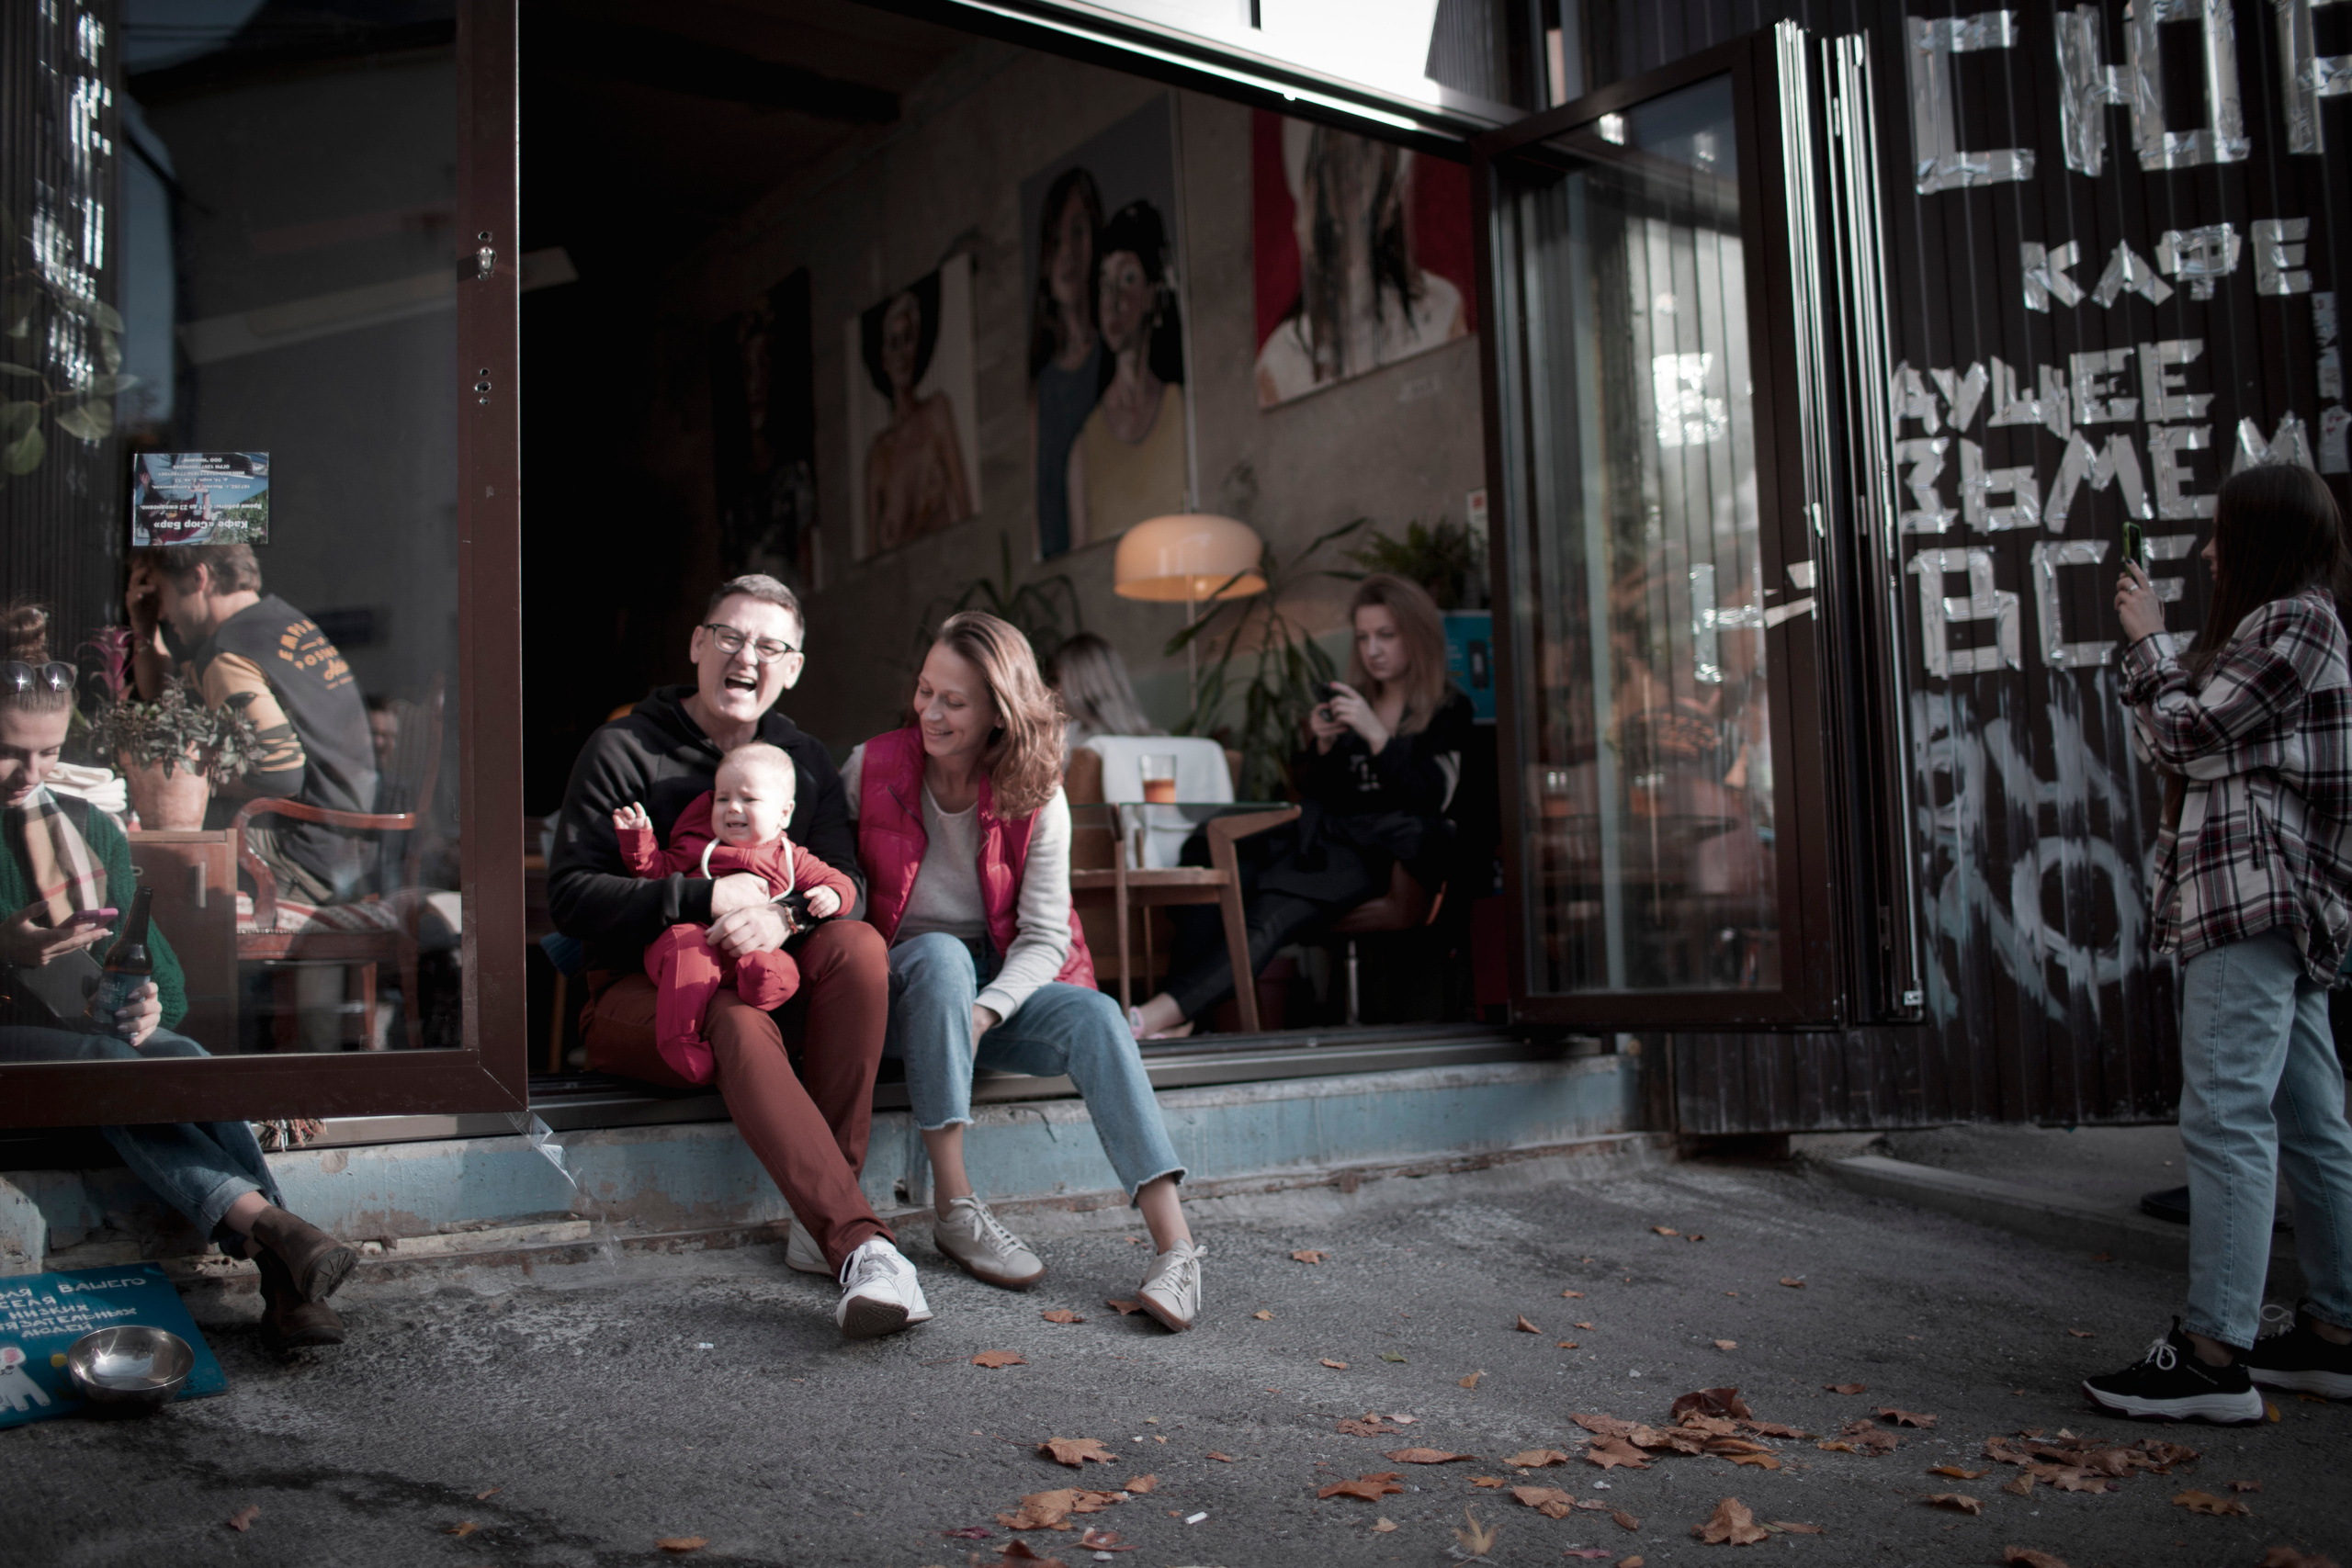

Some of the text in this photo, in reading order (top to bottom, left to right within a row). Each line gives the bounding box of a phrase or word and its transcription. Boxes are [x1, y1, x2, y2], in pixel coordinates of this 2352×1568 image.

[2021, 217, 2312, 313] КАФЕ
[153, 519, 248, 530] Кафе «Сюр Бар»
[57, 1278, 147, 1293] ВАШЕГО
[8, 1304, 90, 1320] НИЗКИХ
[21, 1321, 94, 1337] ЛЮДЕЙ
